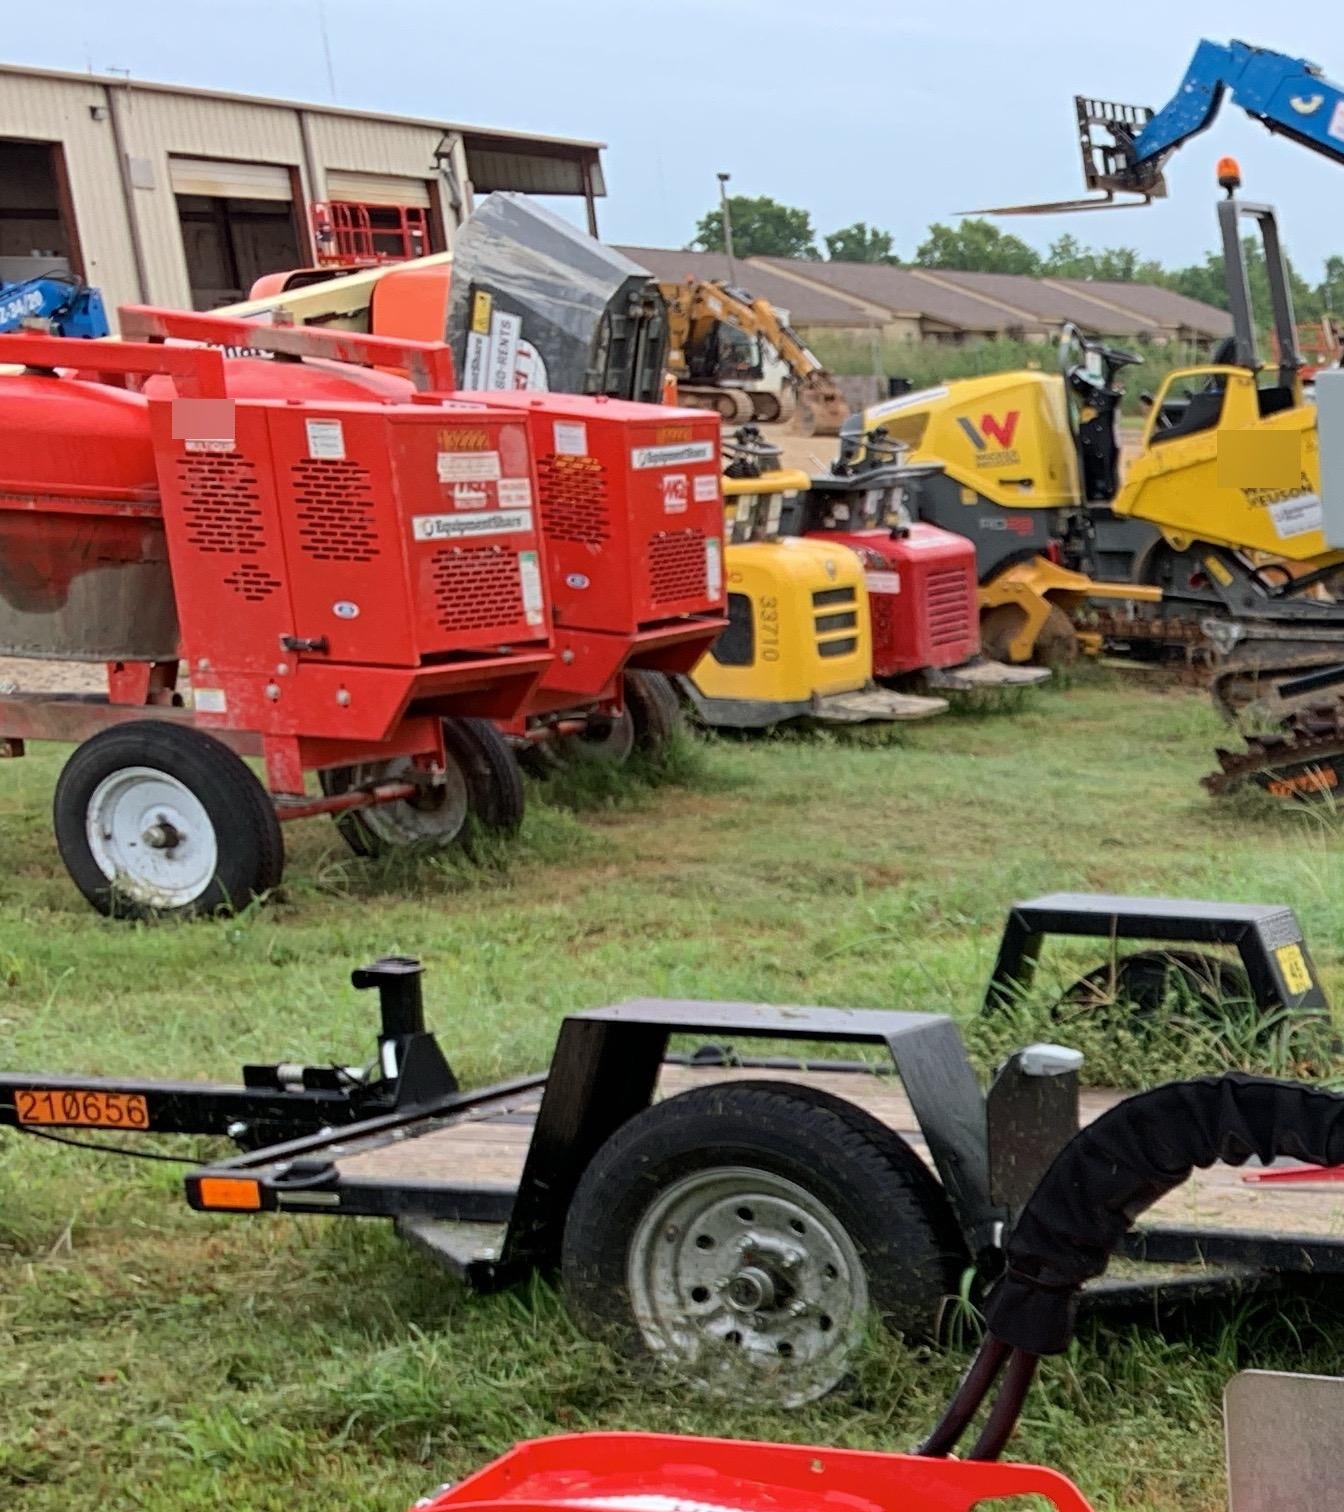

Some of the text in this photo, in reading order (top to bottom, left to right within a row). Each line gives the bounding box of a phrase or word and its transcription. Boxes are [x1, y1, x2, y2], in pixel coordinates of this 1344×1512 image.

[436, 516, 522, 537] EquipmentShare
[760, 596, 780, 662] 33710
[19, 1092, 146, 1125] 210656
